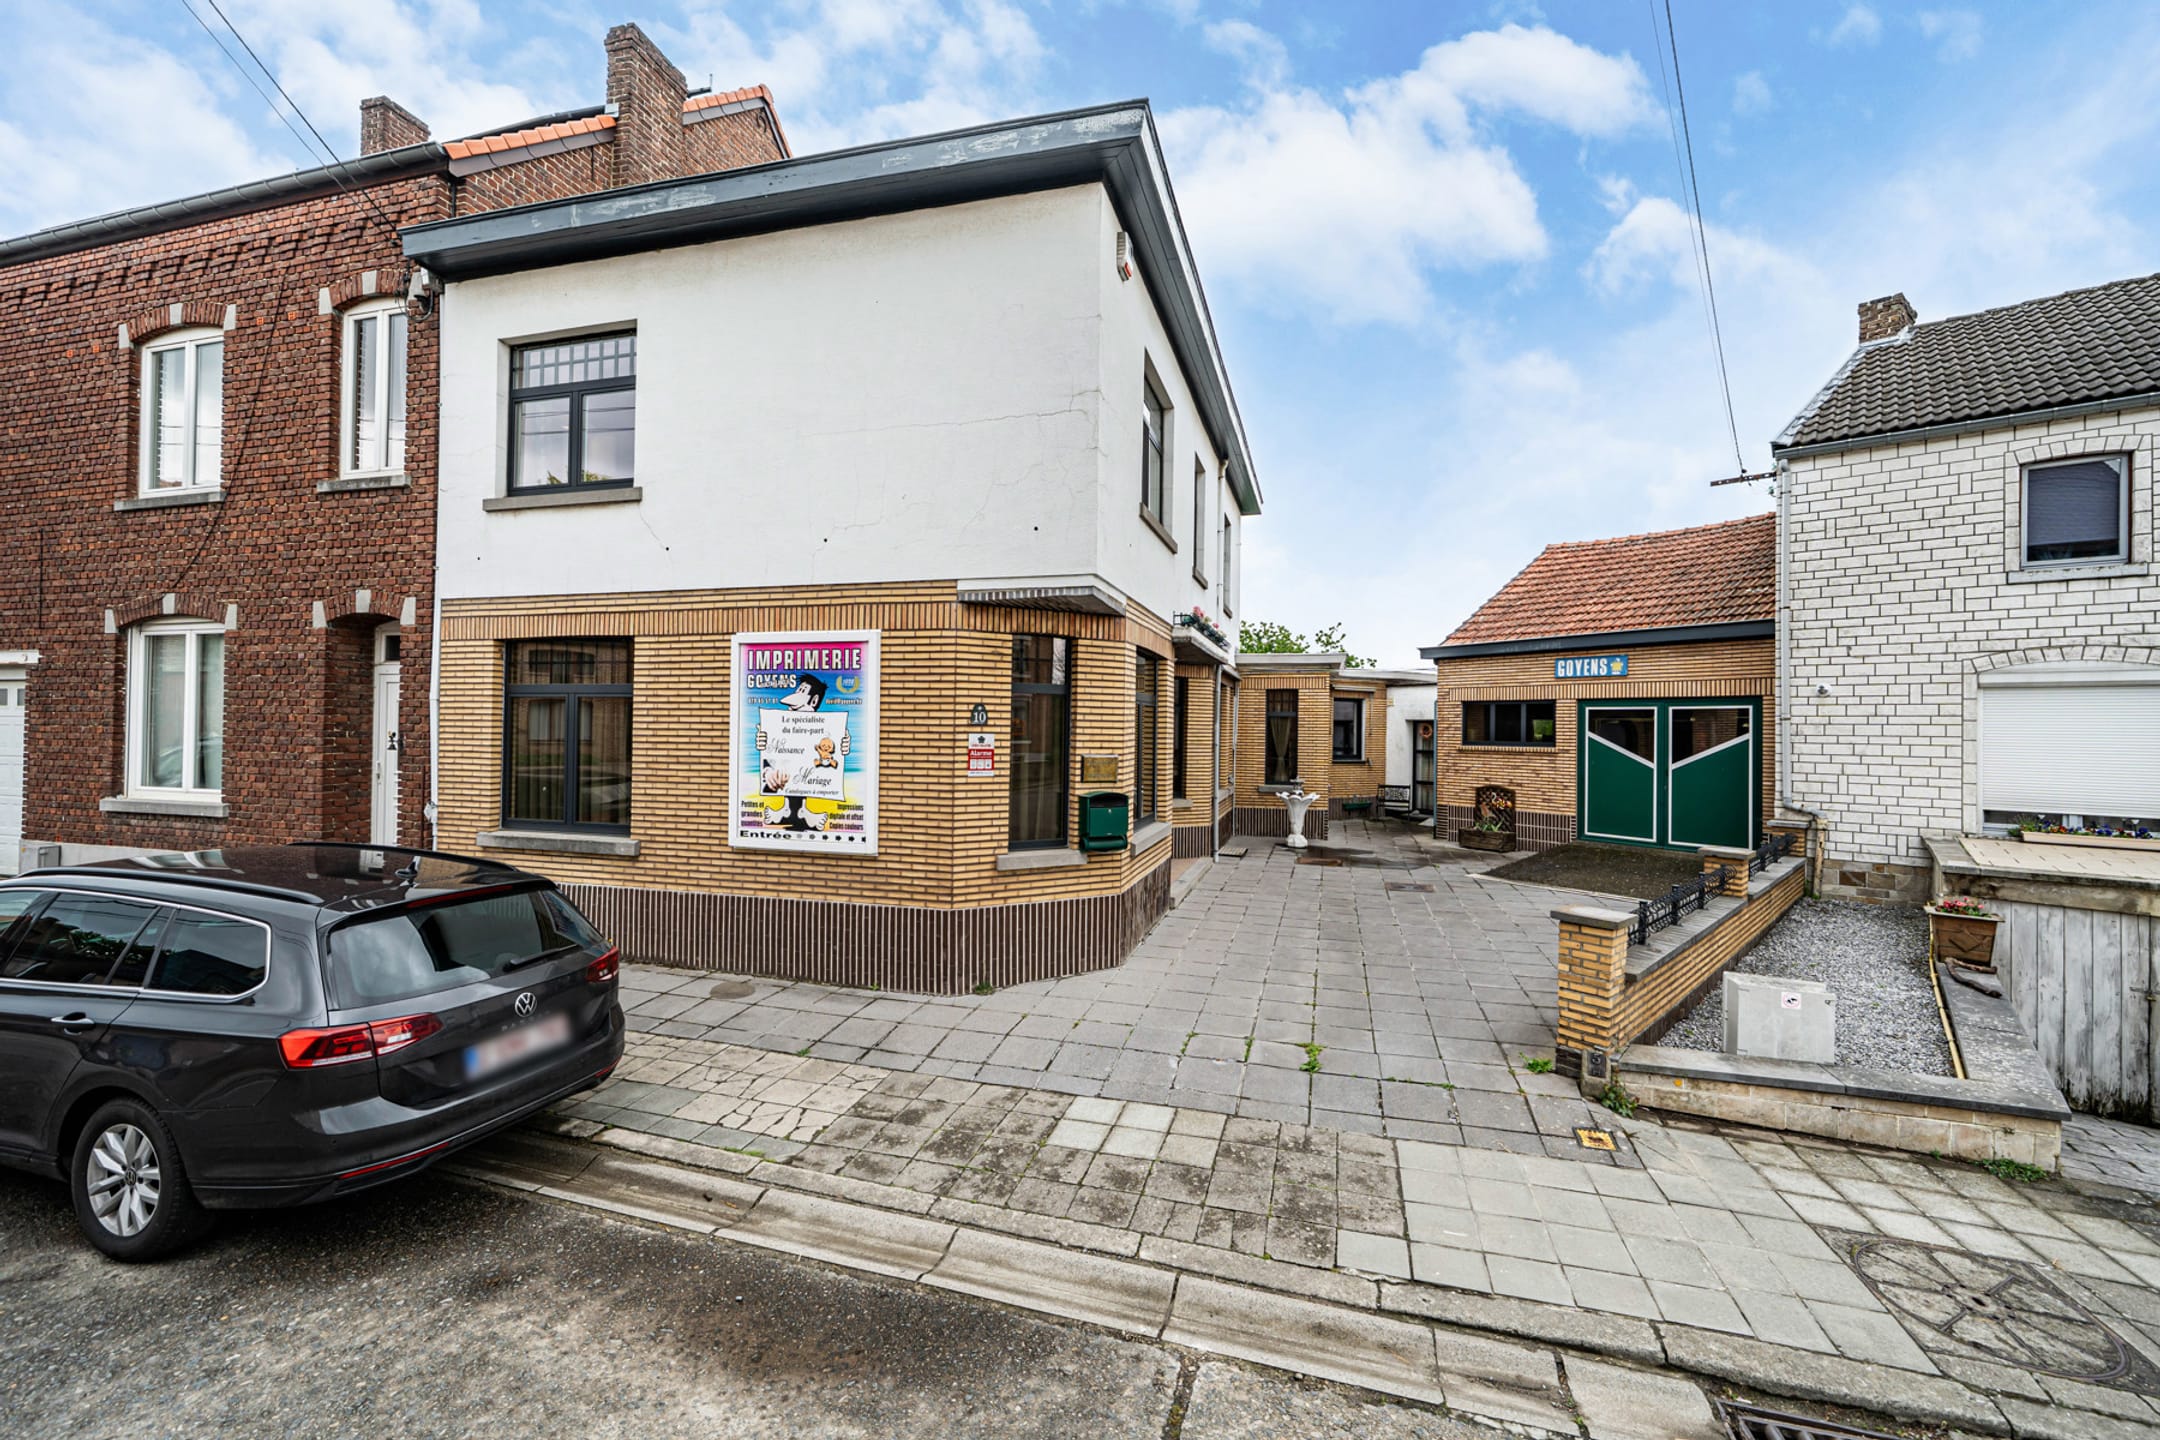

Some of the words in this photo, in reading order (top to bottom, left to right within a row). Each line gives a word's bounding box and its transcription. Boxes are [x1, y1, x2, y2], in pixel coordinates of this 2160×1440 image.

[748, 649, 861, 671] IMPRIMERIE
[1558, 658, 1607, 677] GOYENS
[747, 674, 797, 689] GOYENS
[782, 716, 790, 724] Le
[792, 716, 826, 725] spécialiste
[973, 711, 987, 723] 10
[792, 727, 824, 736] faire-part
[767, 738, 806, 755] Naissance
[793, 767, 832, 788] Mariage
[741, 800, 758, 809] Petites
[837, 803, 864, 812] Impressions
[741, 810, 763, 819] grandes
[740, 830, 792, 839] Entrée
